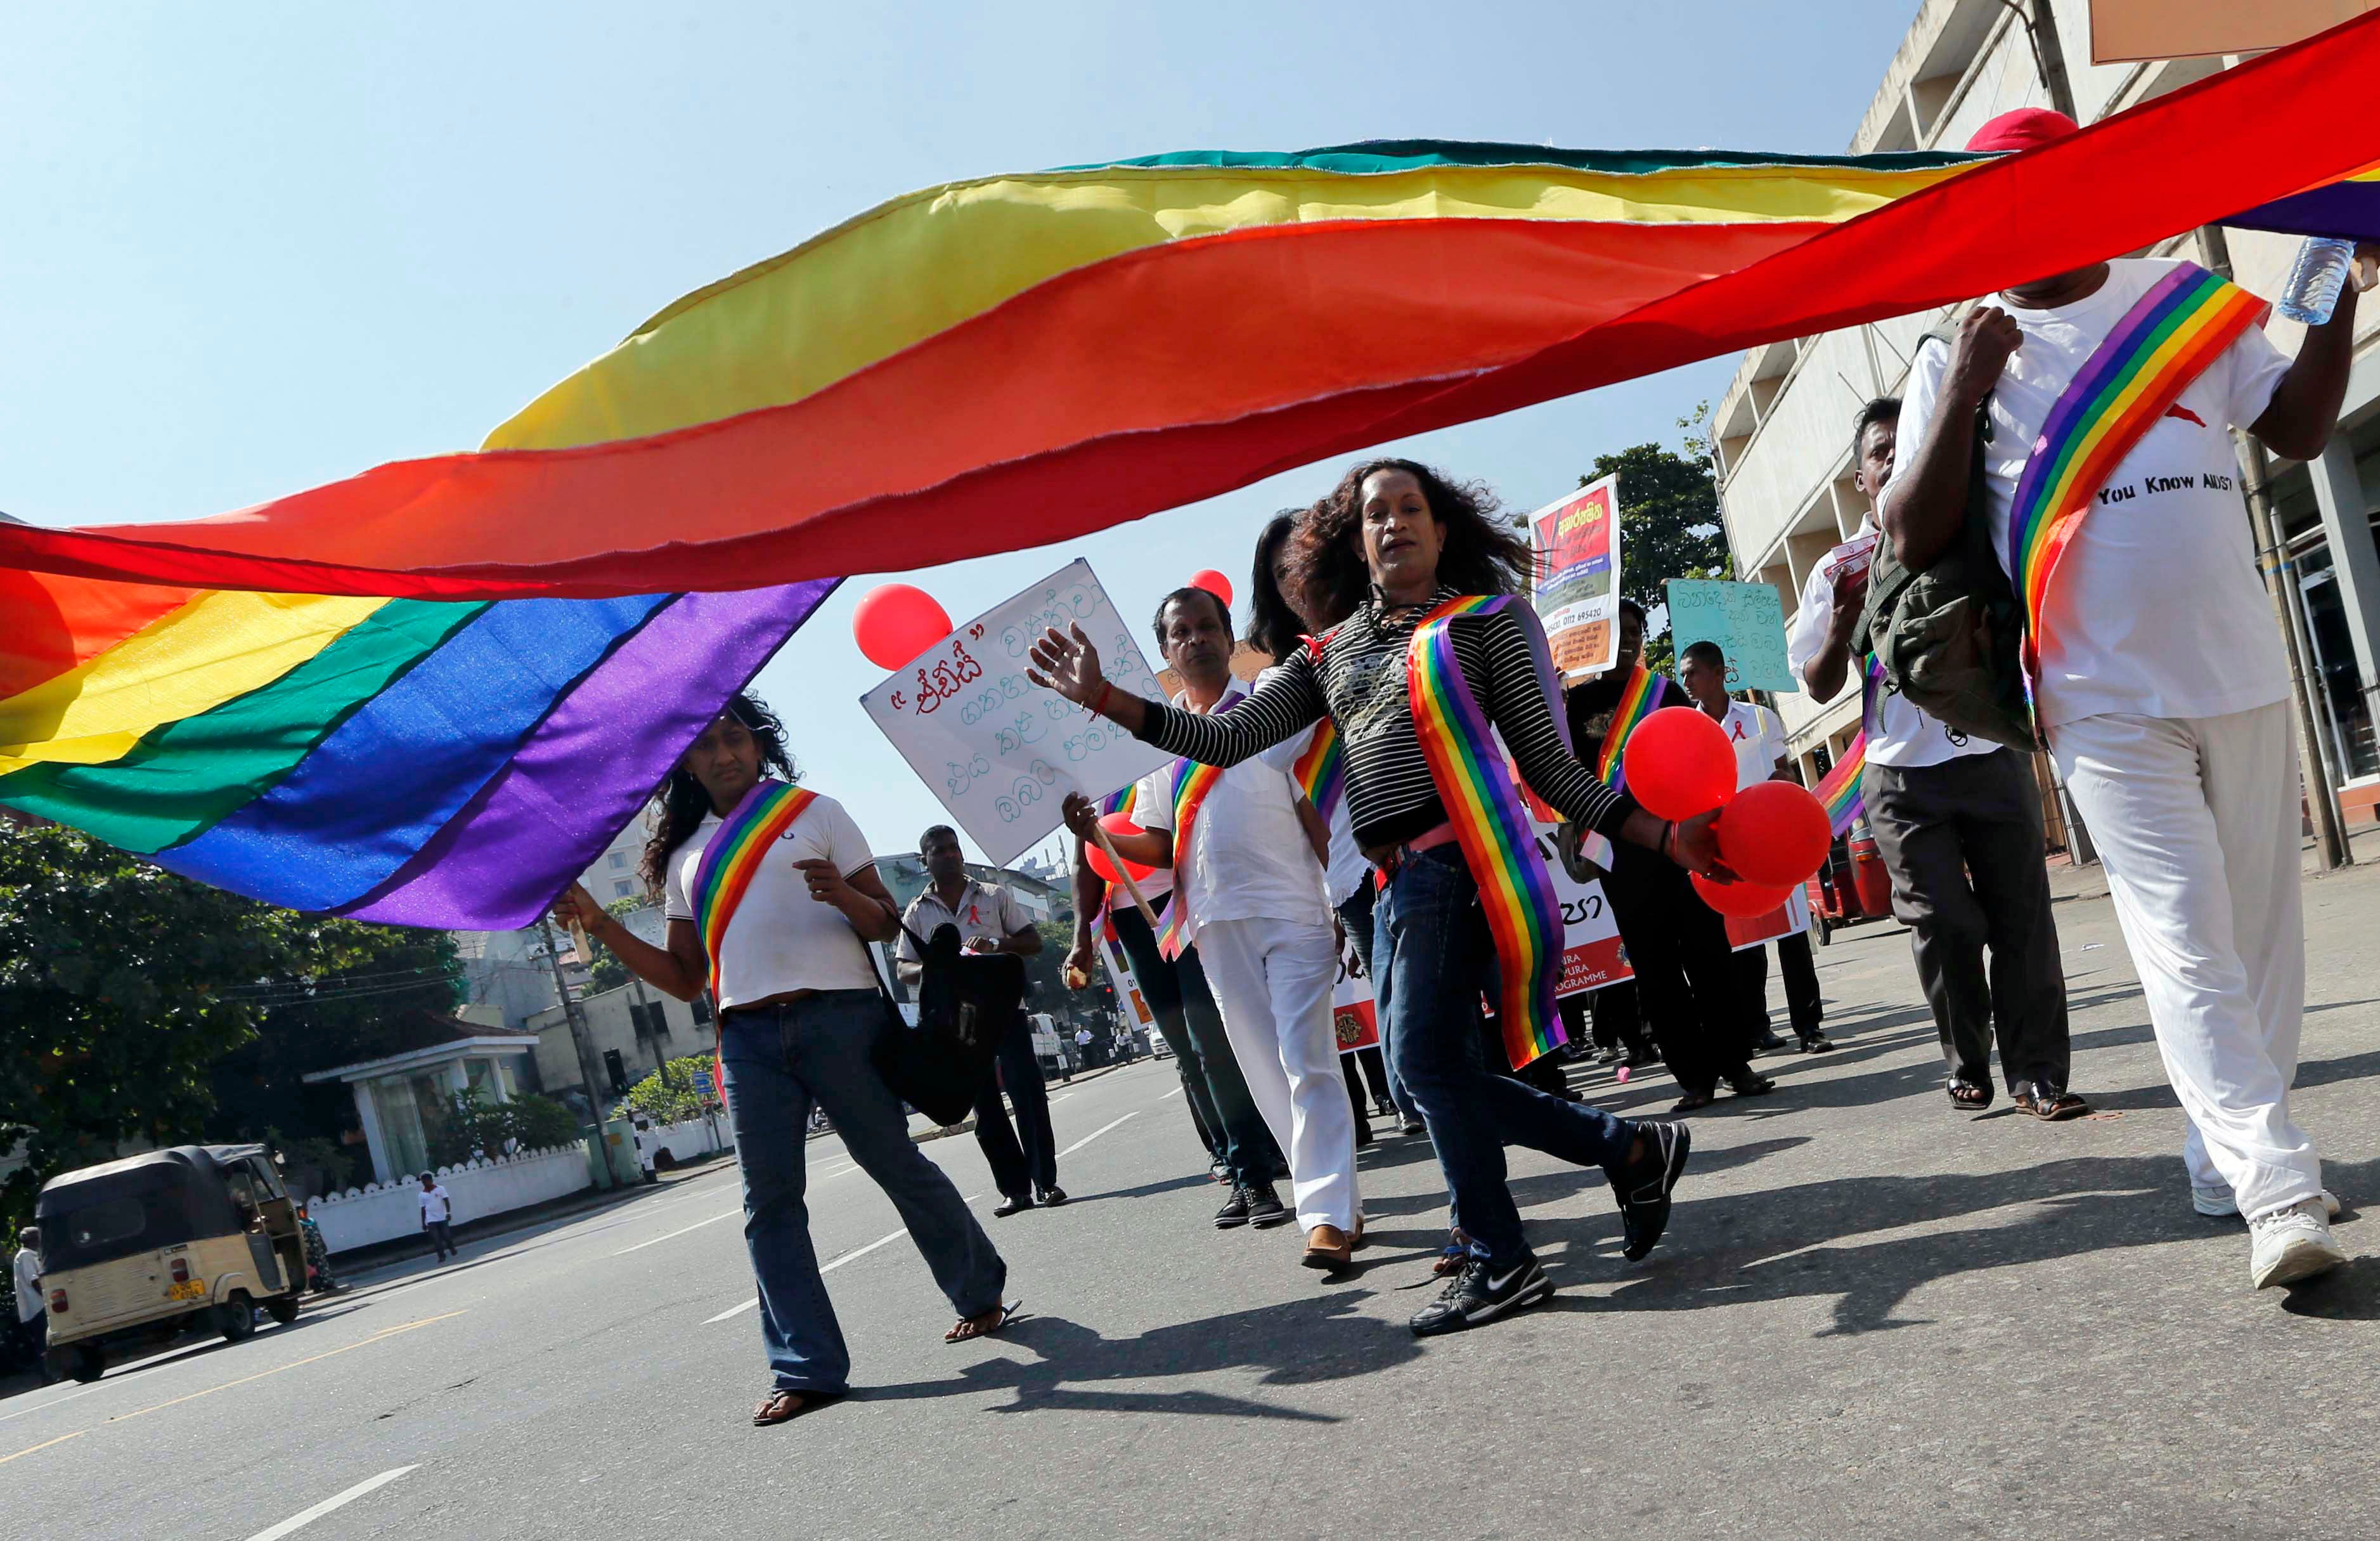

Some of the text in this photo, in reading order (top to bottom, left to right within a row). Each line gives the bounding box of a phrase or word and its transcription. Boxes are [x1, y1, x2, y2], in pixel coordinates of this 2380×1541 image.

[2098, 485, 2136, 505] You
[2145, 476, 2194, 494] Know
[1563, 614, 1575, 625] 0112
[1577, 608, 1602, 621] 695420
[1554, 970, 1608, 992] OGRAMME
